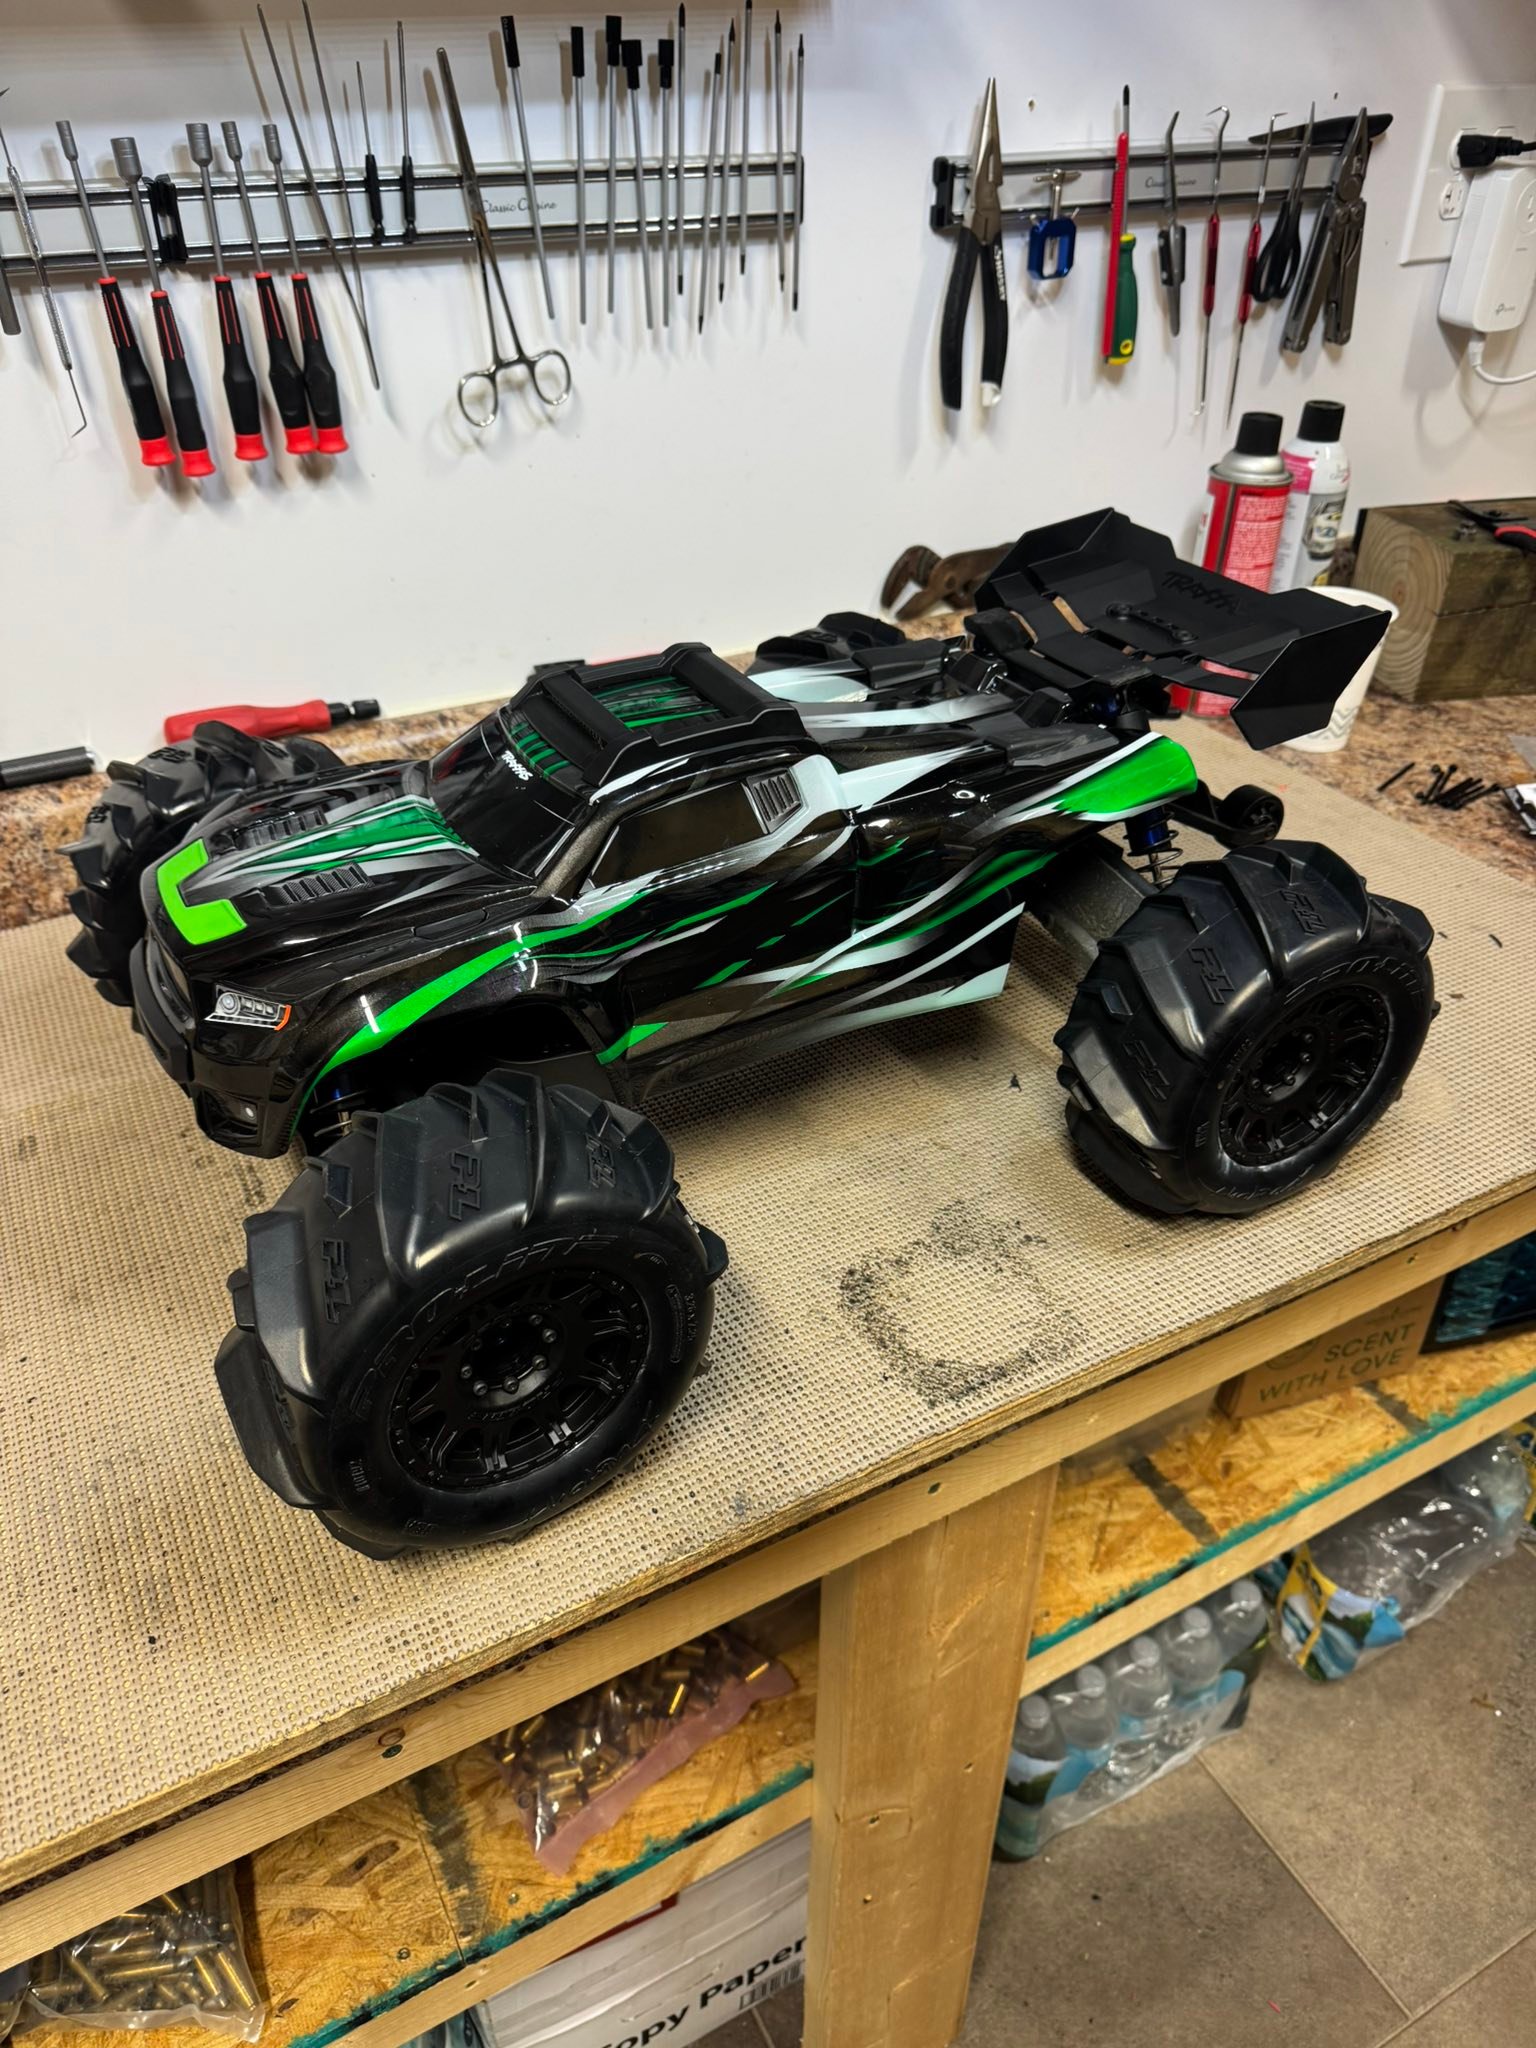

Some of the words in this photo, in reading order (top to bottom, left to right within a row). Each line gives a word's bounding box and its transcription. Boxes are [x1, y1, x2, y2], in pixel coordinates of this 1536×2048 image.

[1323, 1322, 1415, 1364] SCENT
[1259, 1369, 1328, 1402] WITH
[1336, 1348, 1402, 1380] LOVE
[603, 2004, 690, 2048] opy
[700, 1935, 807, 2009] Paper
